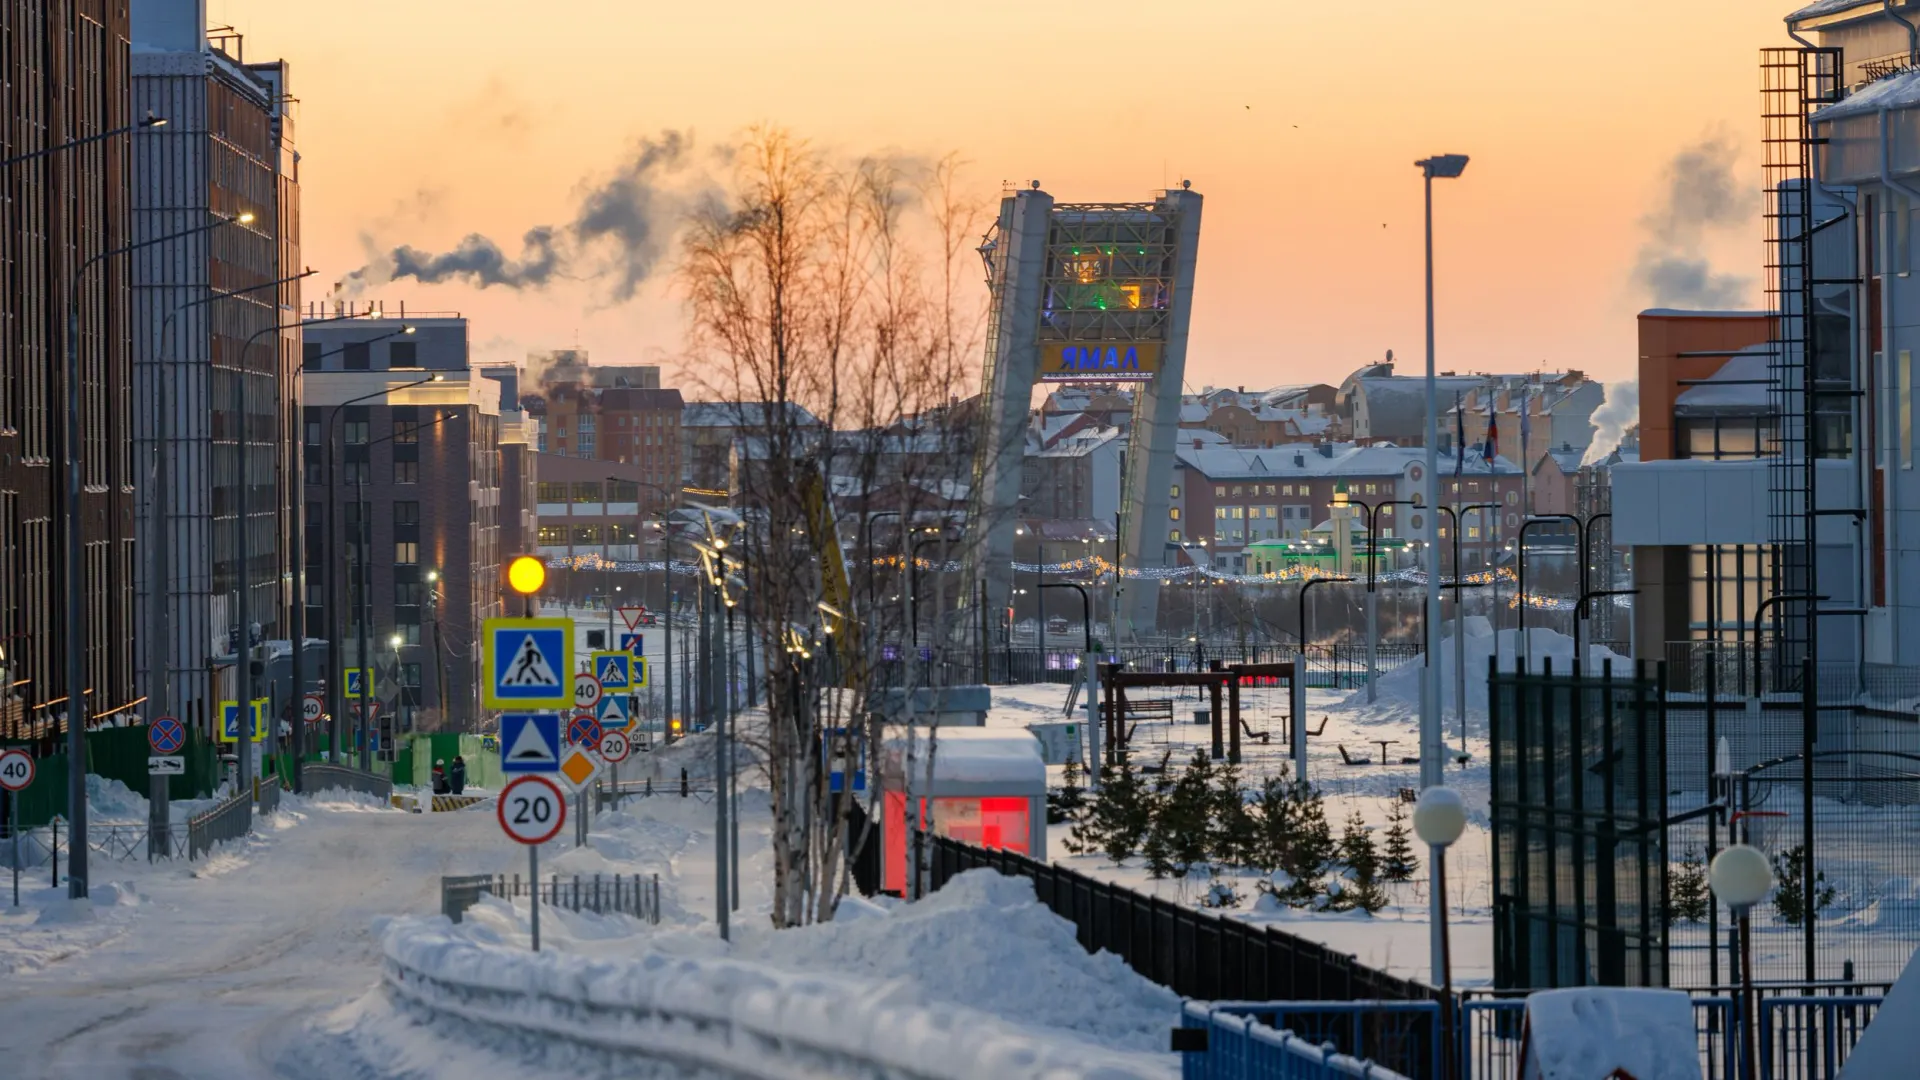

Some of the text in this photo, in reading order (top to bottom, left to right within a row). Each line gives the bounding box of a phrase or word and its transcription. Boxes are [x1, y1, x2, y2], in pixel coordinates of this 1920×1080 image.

[1061, 346, 1139, 369] ЯМАЛ
[575, 684, 595, 698] 40
[303, 704, 318, 714] 40
[605, 740, 623, 753] 20
[3, 762, 26, 778] 40
[513, 796, 550, 824] 20
